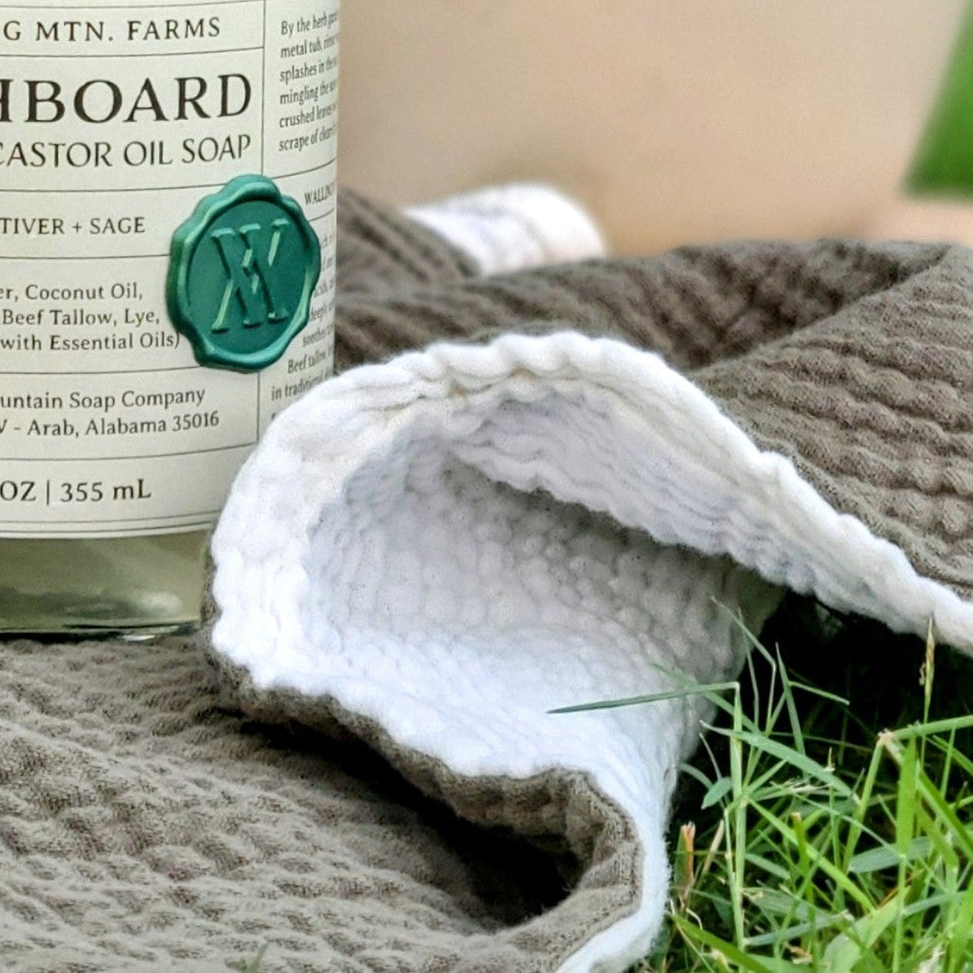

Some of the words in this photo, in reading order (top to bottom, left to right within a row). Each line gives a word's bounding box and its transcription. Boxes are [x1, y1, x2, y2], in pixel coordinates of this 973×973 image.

[35, 21, 114, 42] MTN.
[127, 16, 220, 41] FARMS
[280, 20, 294, 39] By
[296, 16, 311, 33] the
[280, 39, 308, 59] metal
[280, 63, 317, 85] splashes
[280, 84, 319, 106] mingling
[279, 107, 315, 128] crushed
[123, 141, 173, 167] OIL
[181, 134, 251, 164] SOAP
[279, 135, 310, 152] scrape
[89, 216, 146, 235] SAGE
[25, 284, 105, 301] Coconut
[111, 282, 143, 301] Oil,
[2, 309, 45, 325] Beef
[49, 309, 117, 327] Tallow,
[124, 308, 160, 328] Lye,
[50, 333, 133, 351] Essential
[140, 331, 180, 349] Oils)
[287, 353, 309, 375] Beef
[69, 392, 116, 412] Soap
[121, 389, 206, 410] Company
[271, 386, 283, 401] in
[27, 418, 80, 439] Arab,
[84, 417, 167, 436] Alabama
[172, 410, 219, 432] 35016
[0, 480, 37, 502] OZ
[60, 481, 104, 503] 355
[113, 478, 152, 501] mL
